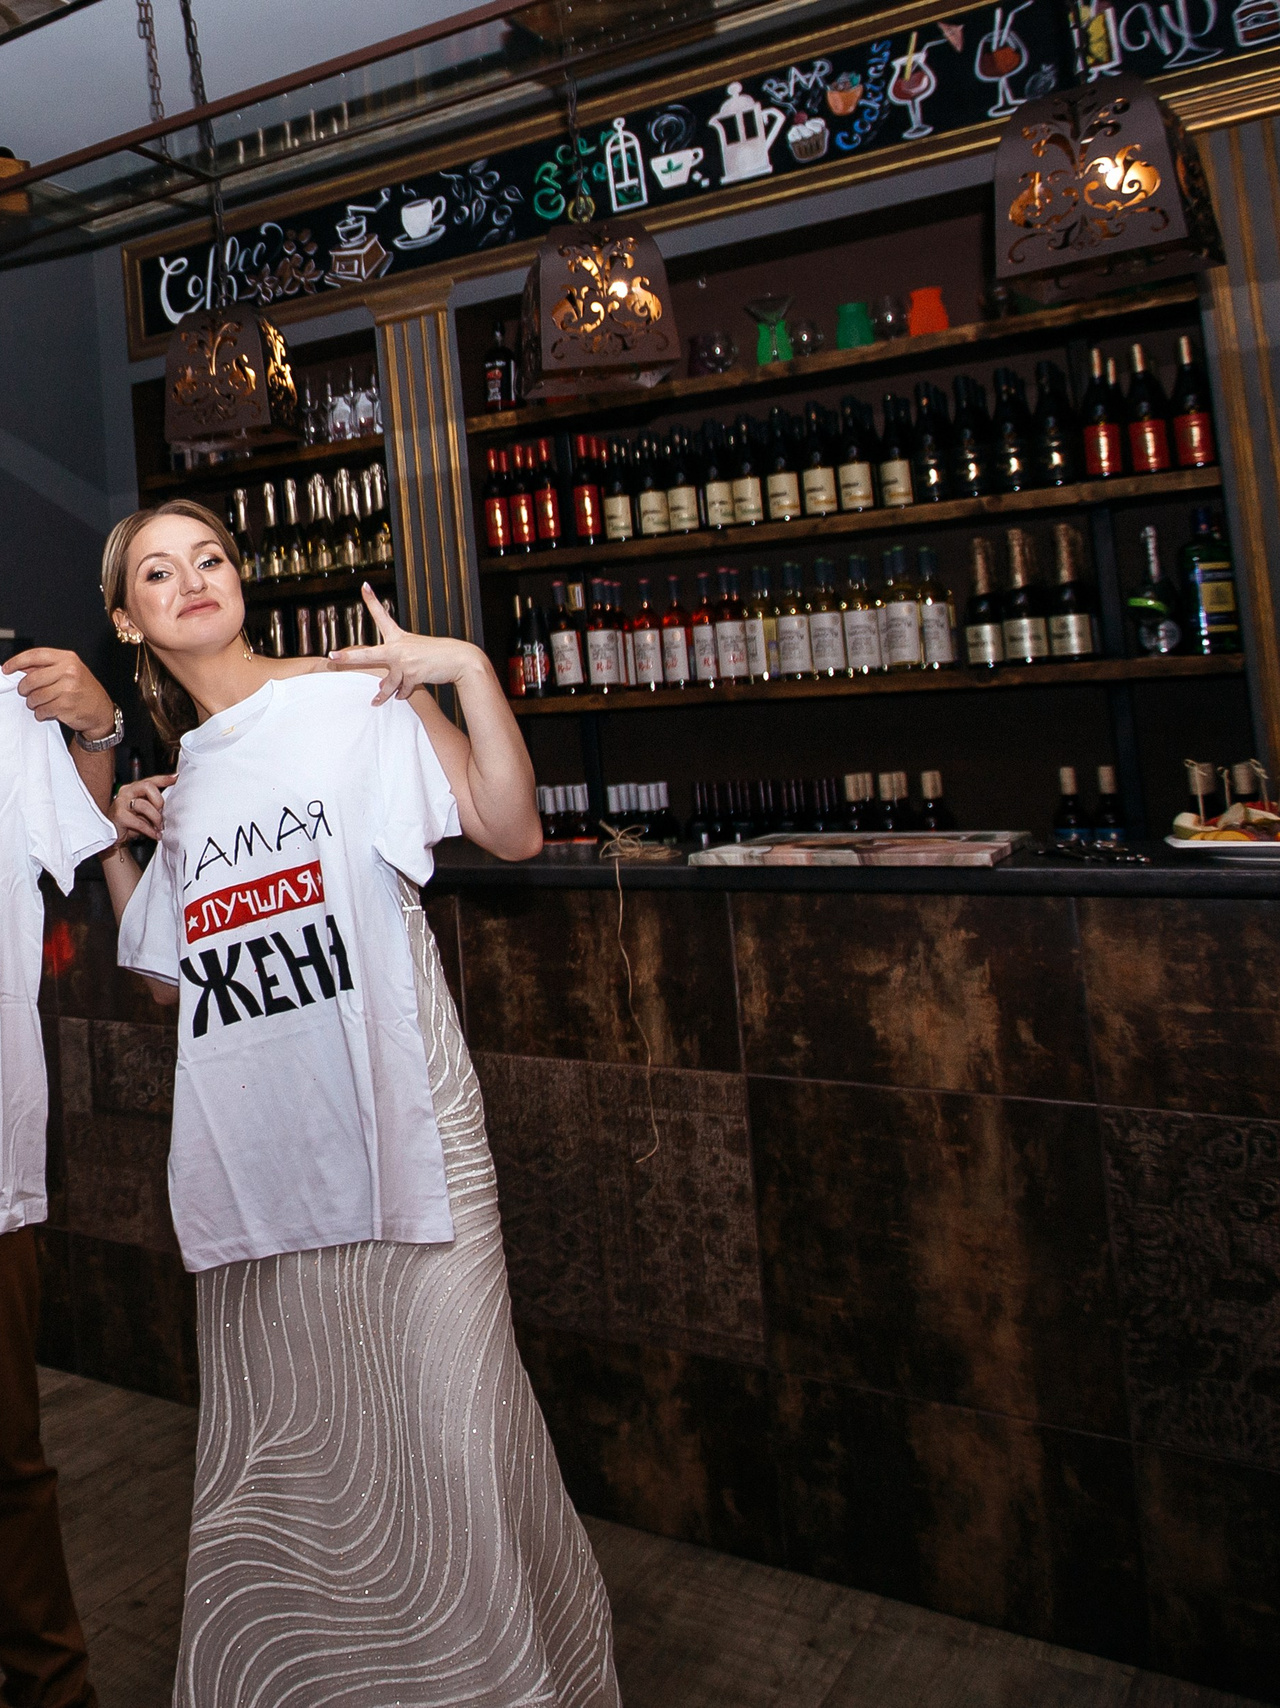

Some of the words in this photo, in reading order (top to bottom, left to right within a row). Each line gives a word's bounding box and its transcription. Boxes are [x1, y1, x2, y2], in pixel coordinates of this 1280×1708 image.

[762, 58, 833, 100] BAR
[183, 799, 332, 892] АМАЯ
[201, 869, 320, 932] ЛУЧШАЯ
